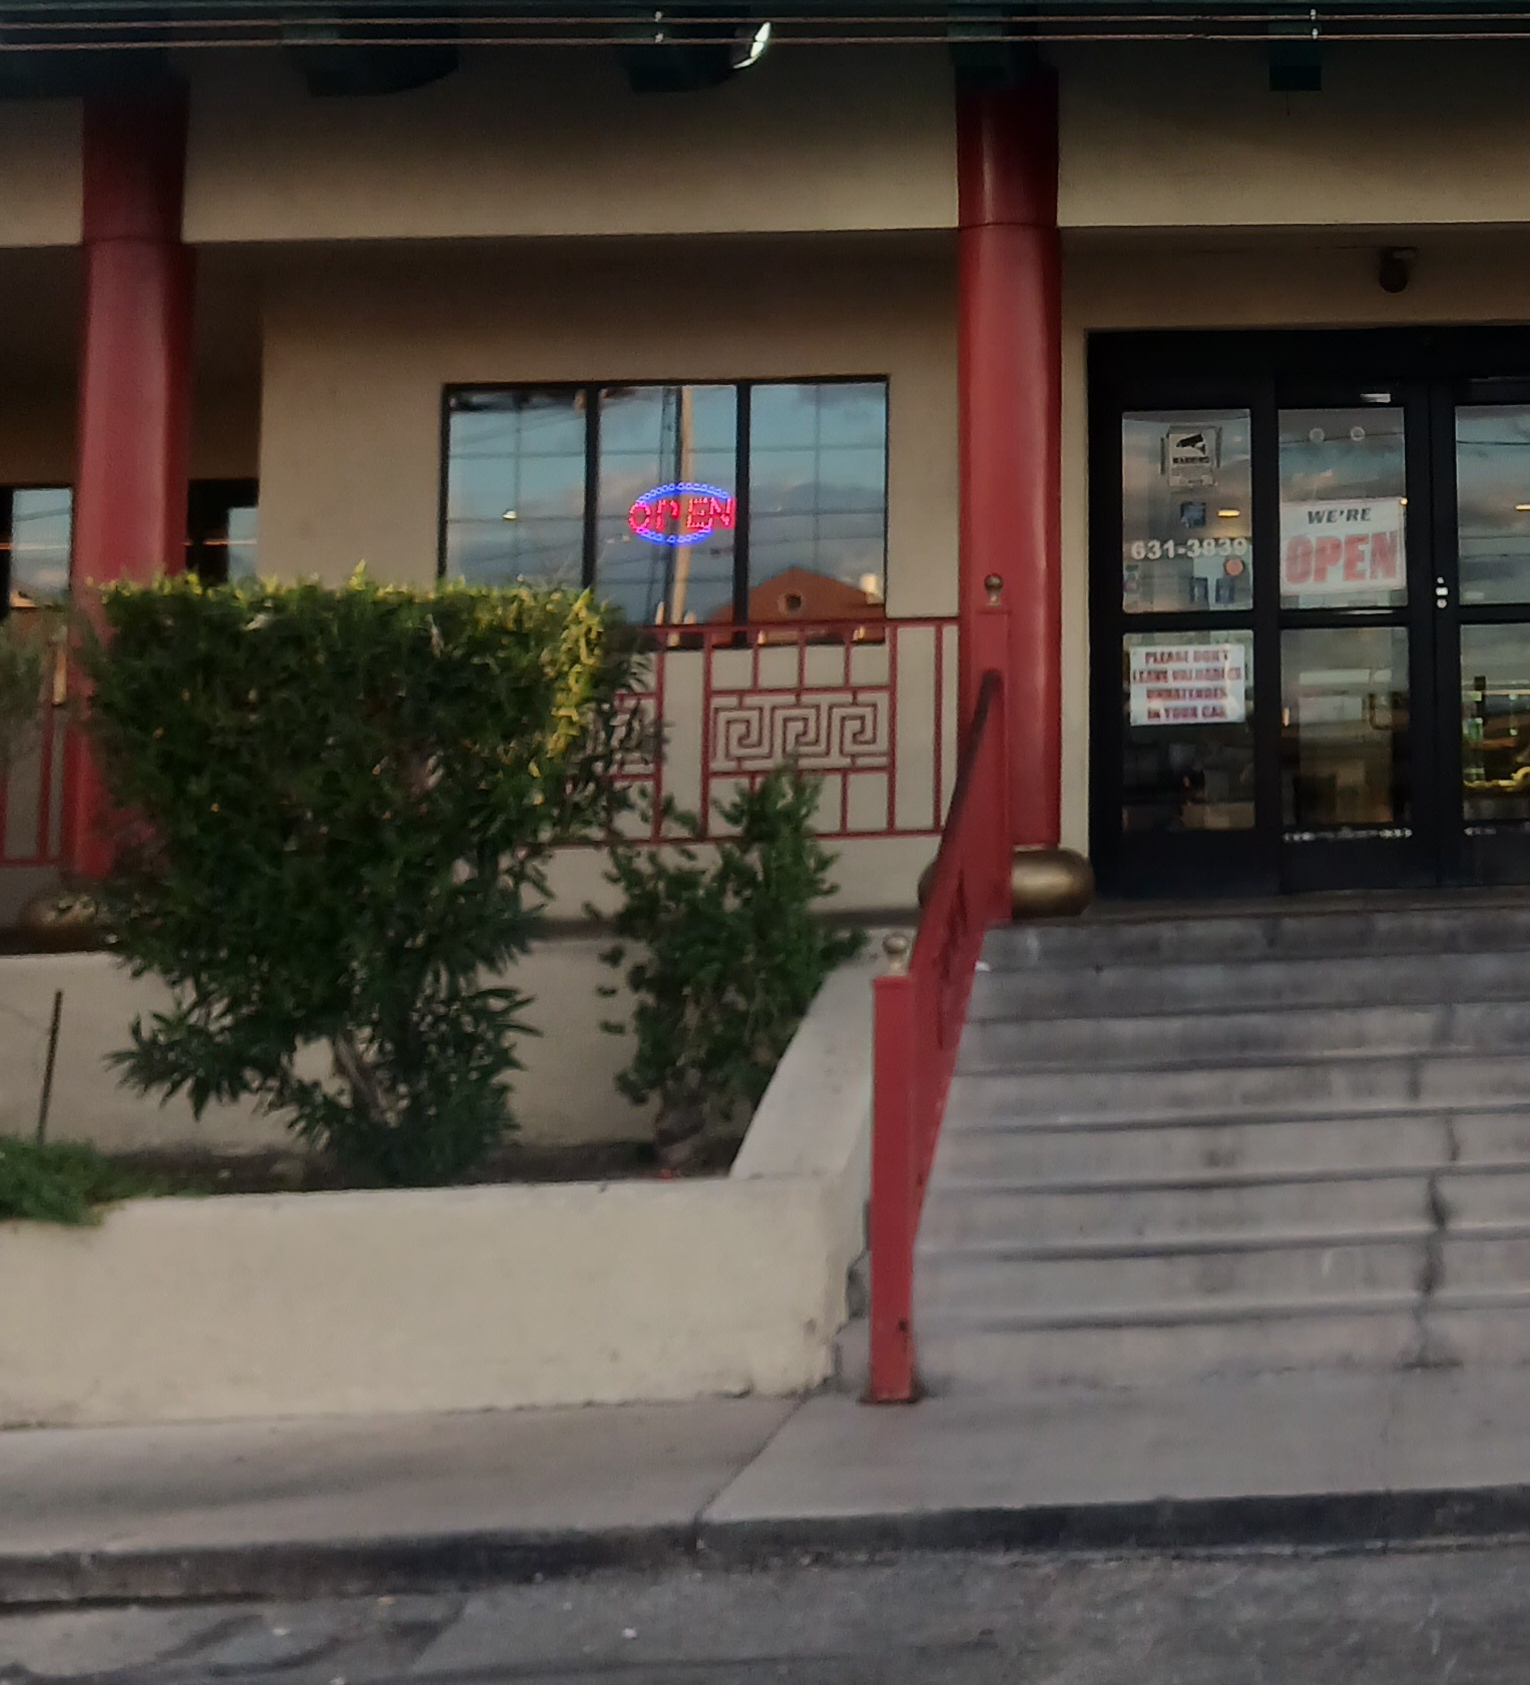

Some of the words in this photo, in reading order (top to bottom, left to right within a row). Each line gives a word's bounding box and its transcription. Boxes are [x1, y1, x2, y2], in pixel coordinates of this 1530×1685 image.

[628, 496, 736, 531] OPEN
[1307, 508, 1372, 525] WE'RE
[1131, 537, 1248, 560] 631-3839
[1285, 530, 1398, 584] OPEN
